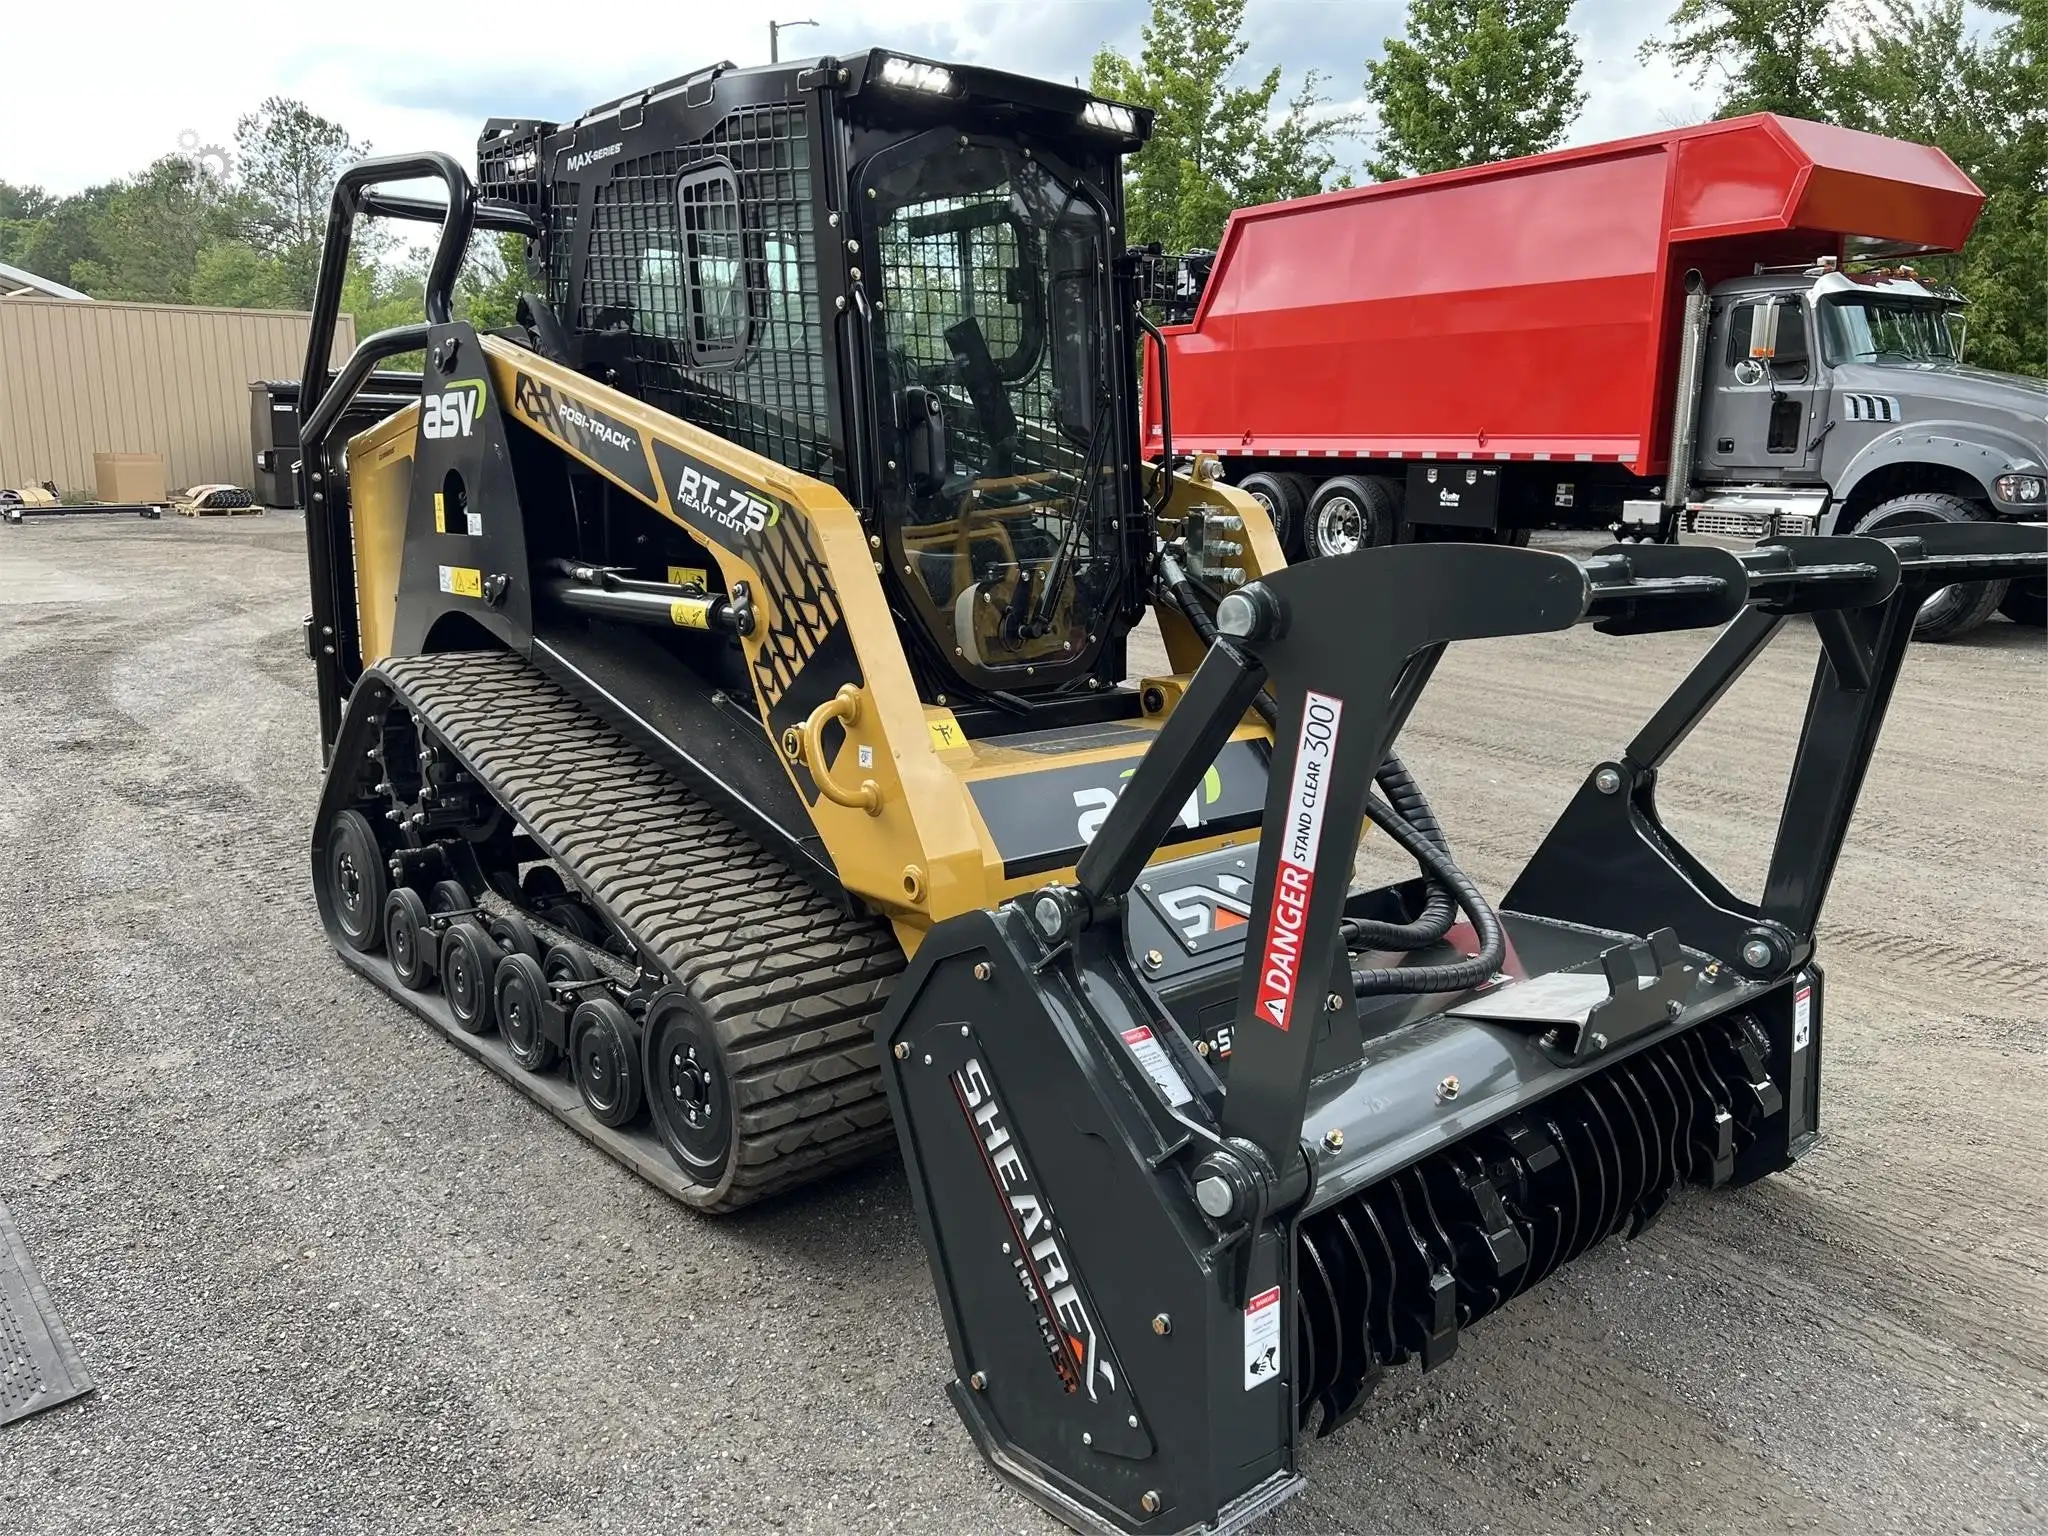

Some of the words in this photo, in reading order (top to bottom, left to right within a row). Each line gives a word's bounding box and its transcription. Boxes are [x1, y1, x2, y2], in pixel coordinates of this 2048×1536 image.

[566, 142, 623, 171] MAX-SERIES
[558, 403, 631, 452] POSI-TRACK
[677, 492, 719, 520] HEAVY
[717, 510, 750, 537] DUTY
[678, 465, 768, 532] RT-75
[1302, 761, 1321, 809] CLEAR
[1293, 812, 1313, 862] STAND
[1265, 867, 1309, 995] DANGER
